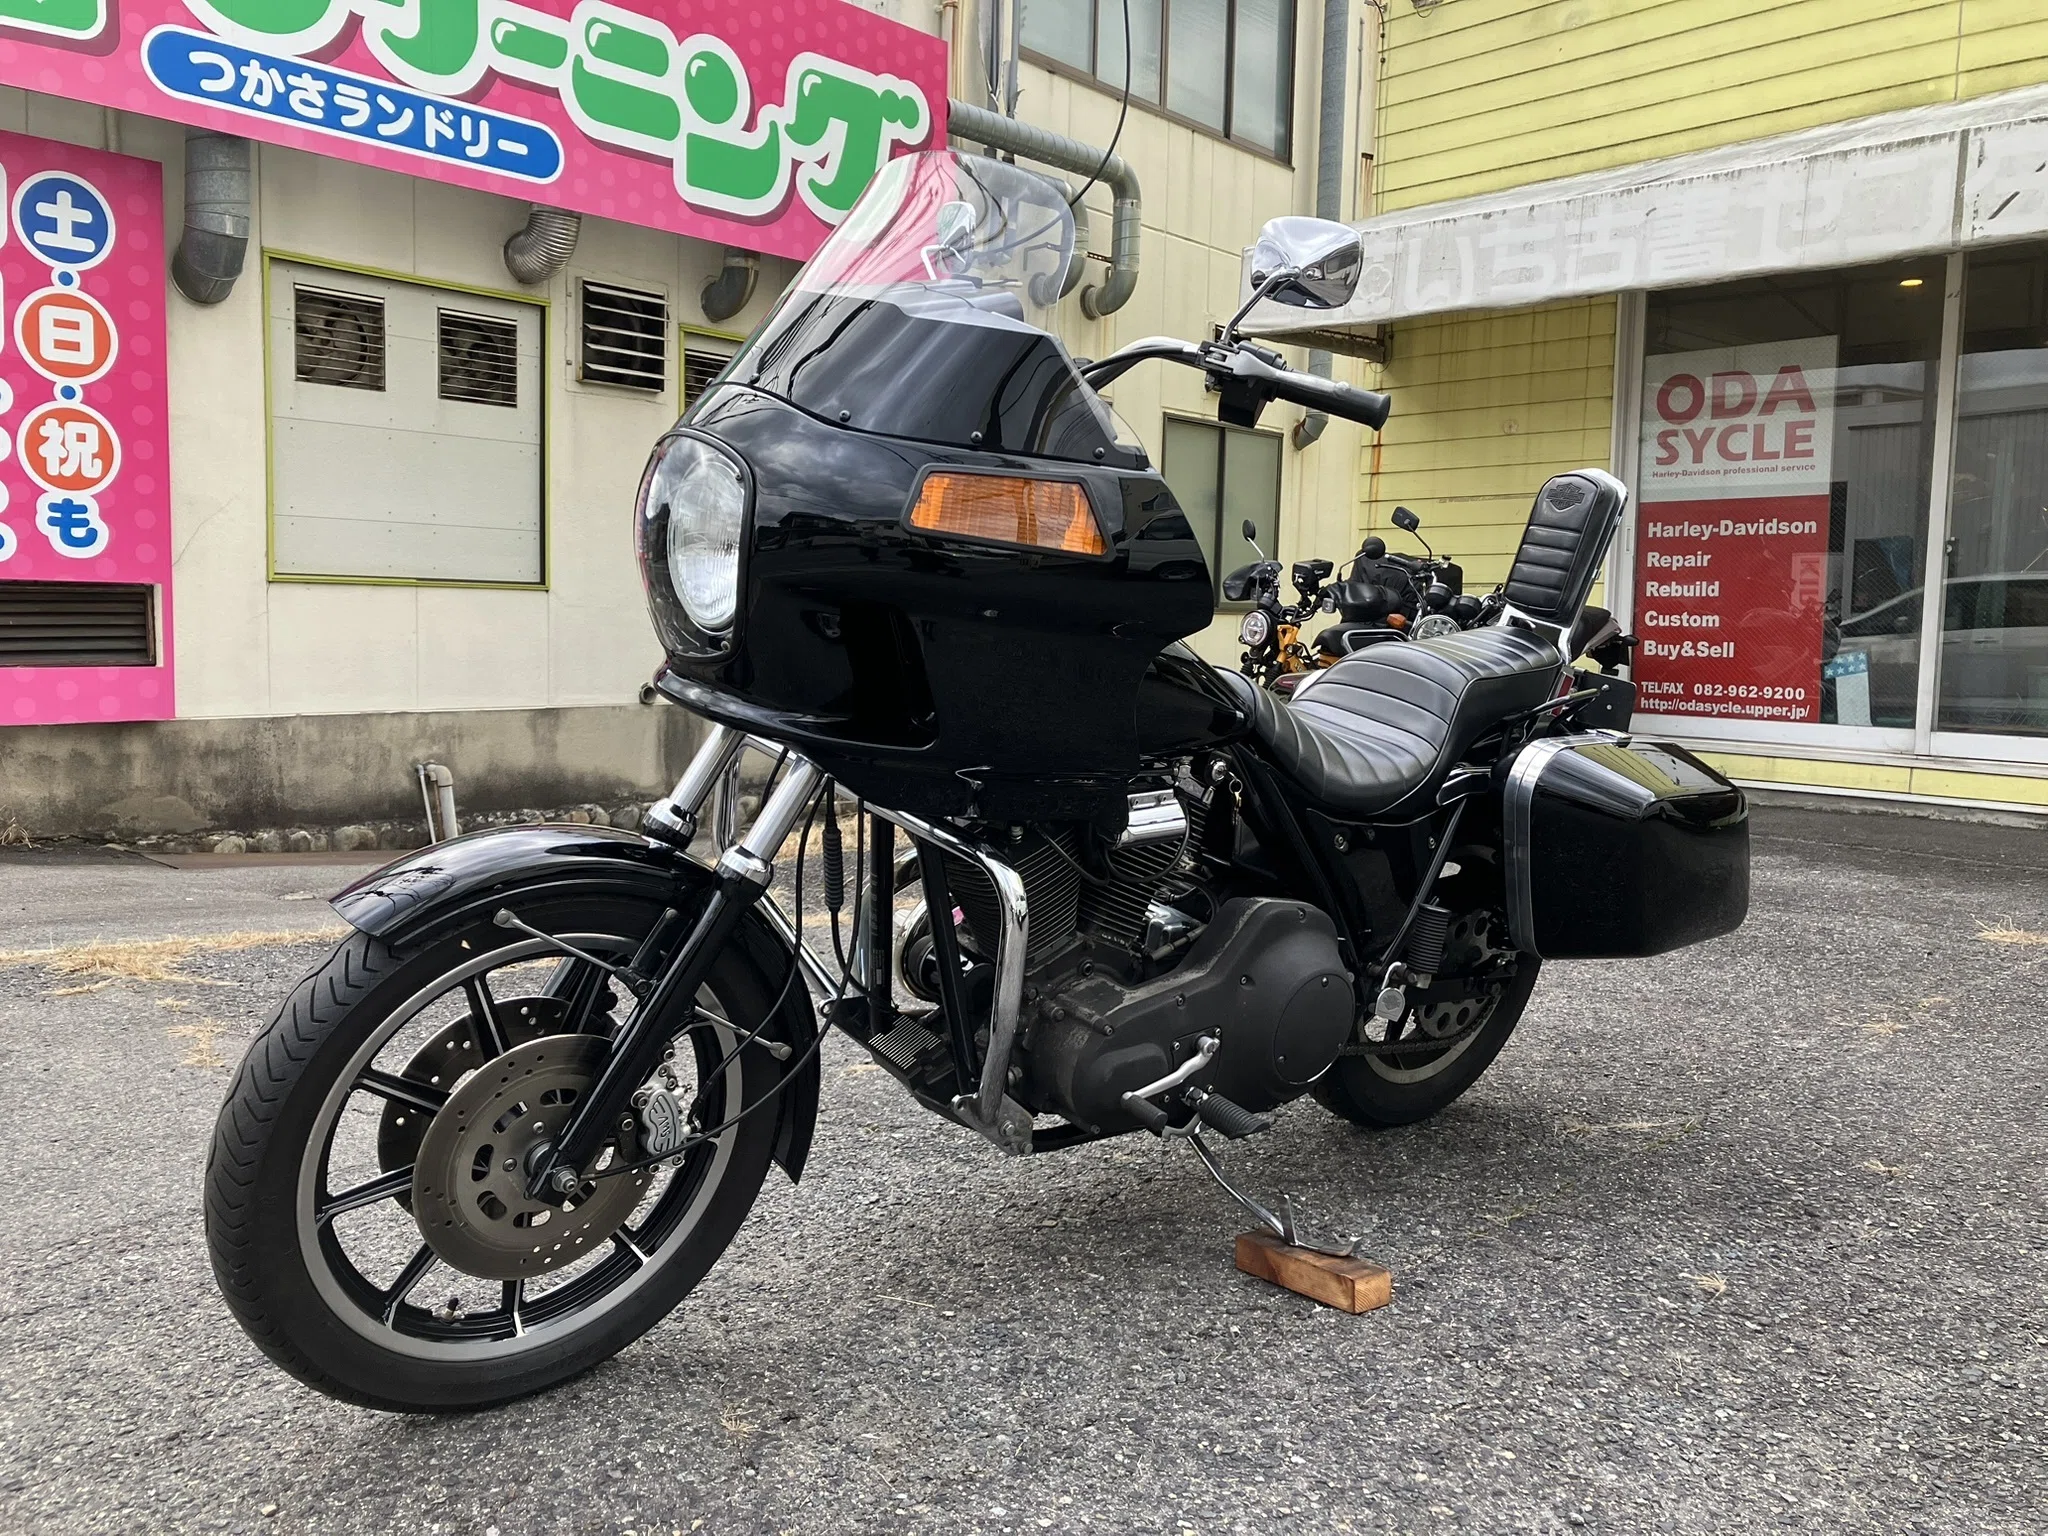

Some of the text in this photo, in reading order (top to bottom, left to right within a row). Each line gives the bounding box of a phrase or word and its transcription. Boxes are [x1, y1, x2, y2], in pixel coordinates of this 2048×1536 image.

[188, 50, 528, 158] つかさランドリー
[195, 0, 921, 212] リーニング
[1656, 365, 1817, 425] ODA
[1655, 420, 1815, 466] SYCLE
[1652, 464, 1816, 478] Harley-Davidson professional service
[1648, 518, 1817, 540] Harley-Davidson
[1647, 551, 1711, 571] Repair
[1646, 581, 1720, 597] Rebuild
[1644, 610, 1720, 628] Custom
[1643, 640, 1735, 660] Buy&Sell
[1641, 682, 1805, 700] TEL/FAX 082-962-9200
[1640, 697, 1810, 719] http://odasycle.upper.jp/
